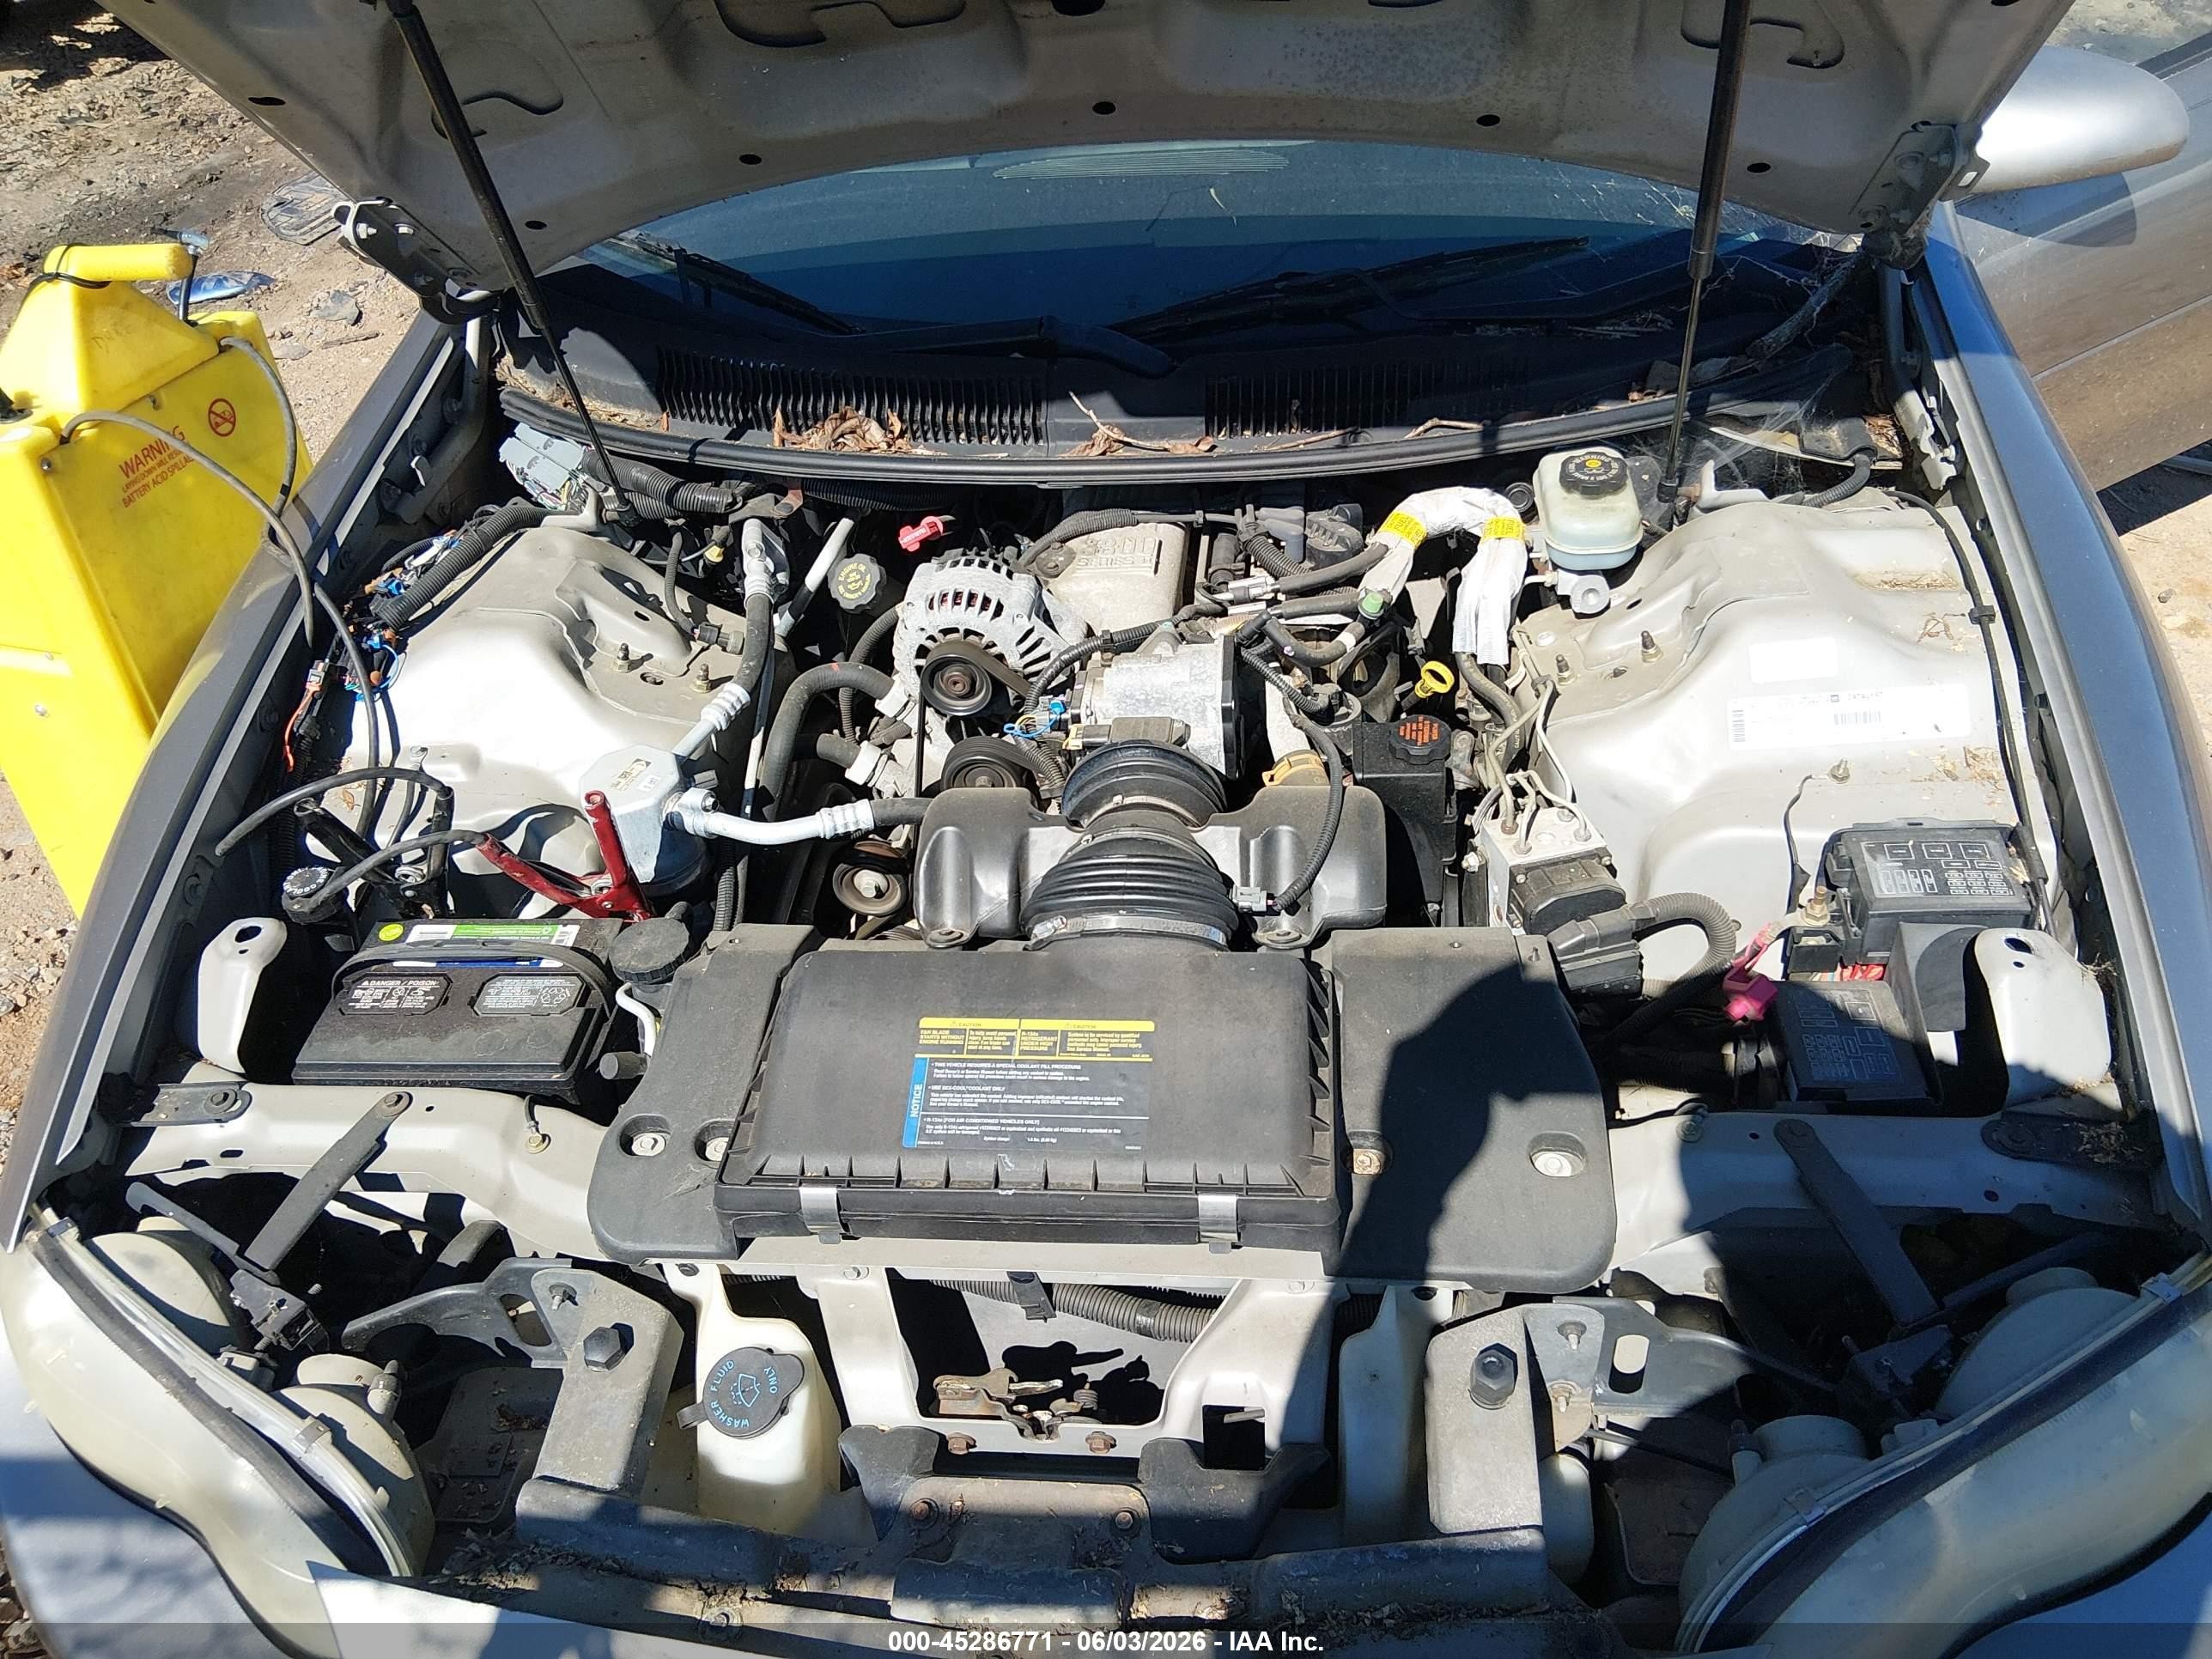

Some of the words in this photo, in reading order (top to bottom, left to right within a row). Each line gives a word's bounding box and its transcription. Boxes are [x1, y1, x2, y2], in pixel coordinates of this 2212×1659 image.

[118, 425, 185, 478] WARNIG
[122, 481, 152, 508] BATTERY
[152, 470, 168, 488] ACID
[909, 1084, 923, 1117] NOTICE
[710, 1360, 735, 1392] FLUID
[763, 1366, 778, 1394] ONLY
[711, 1401, 750, 1428] WASHER
